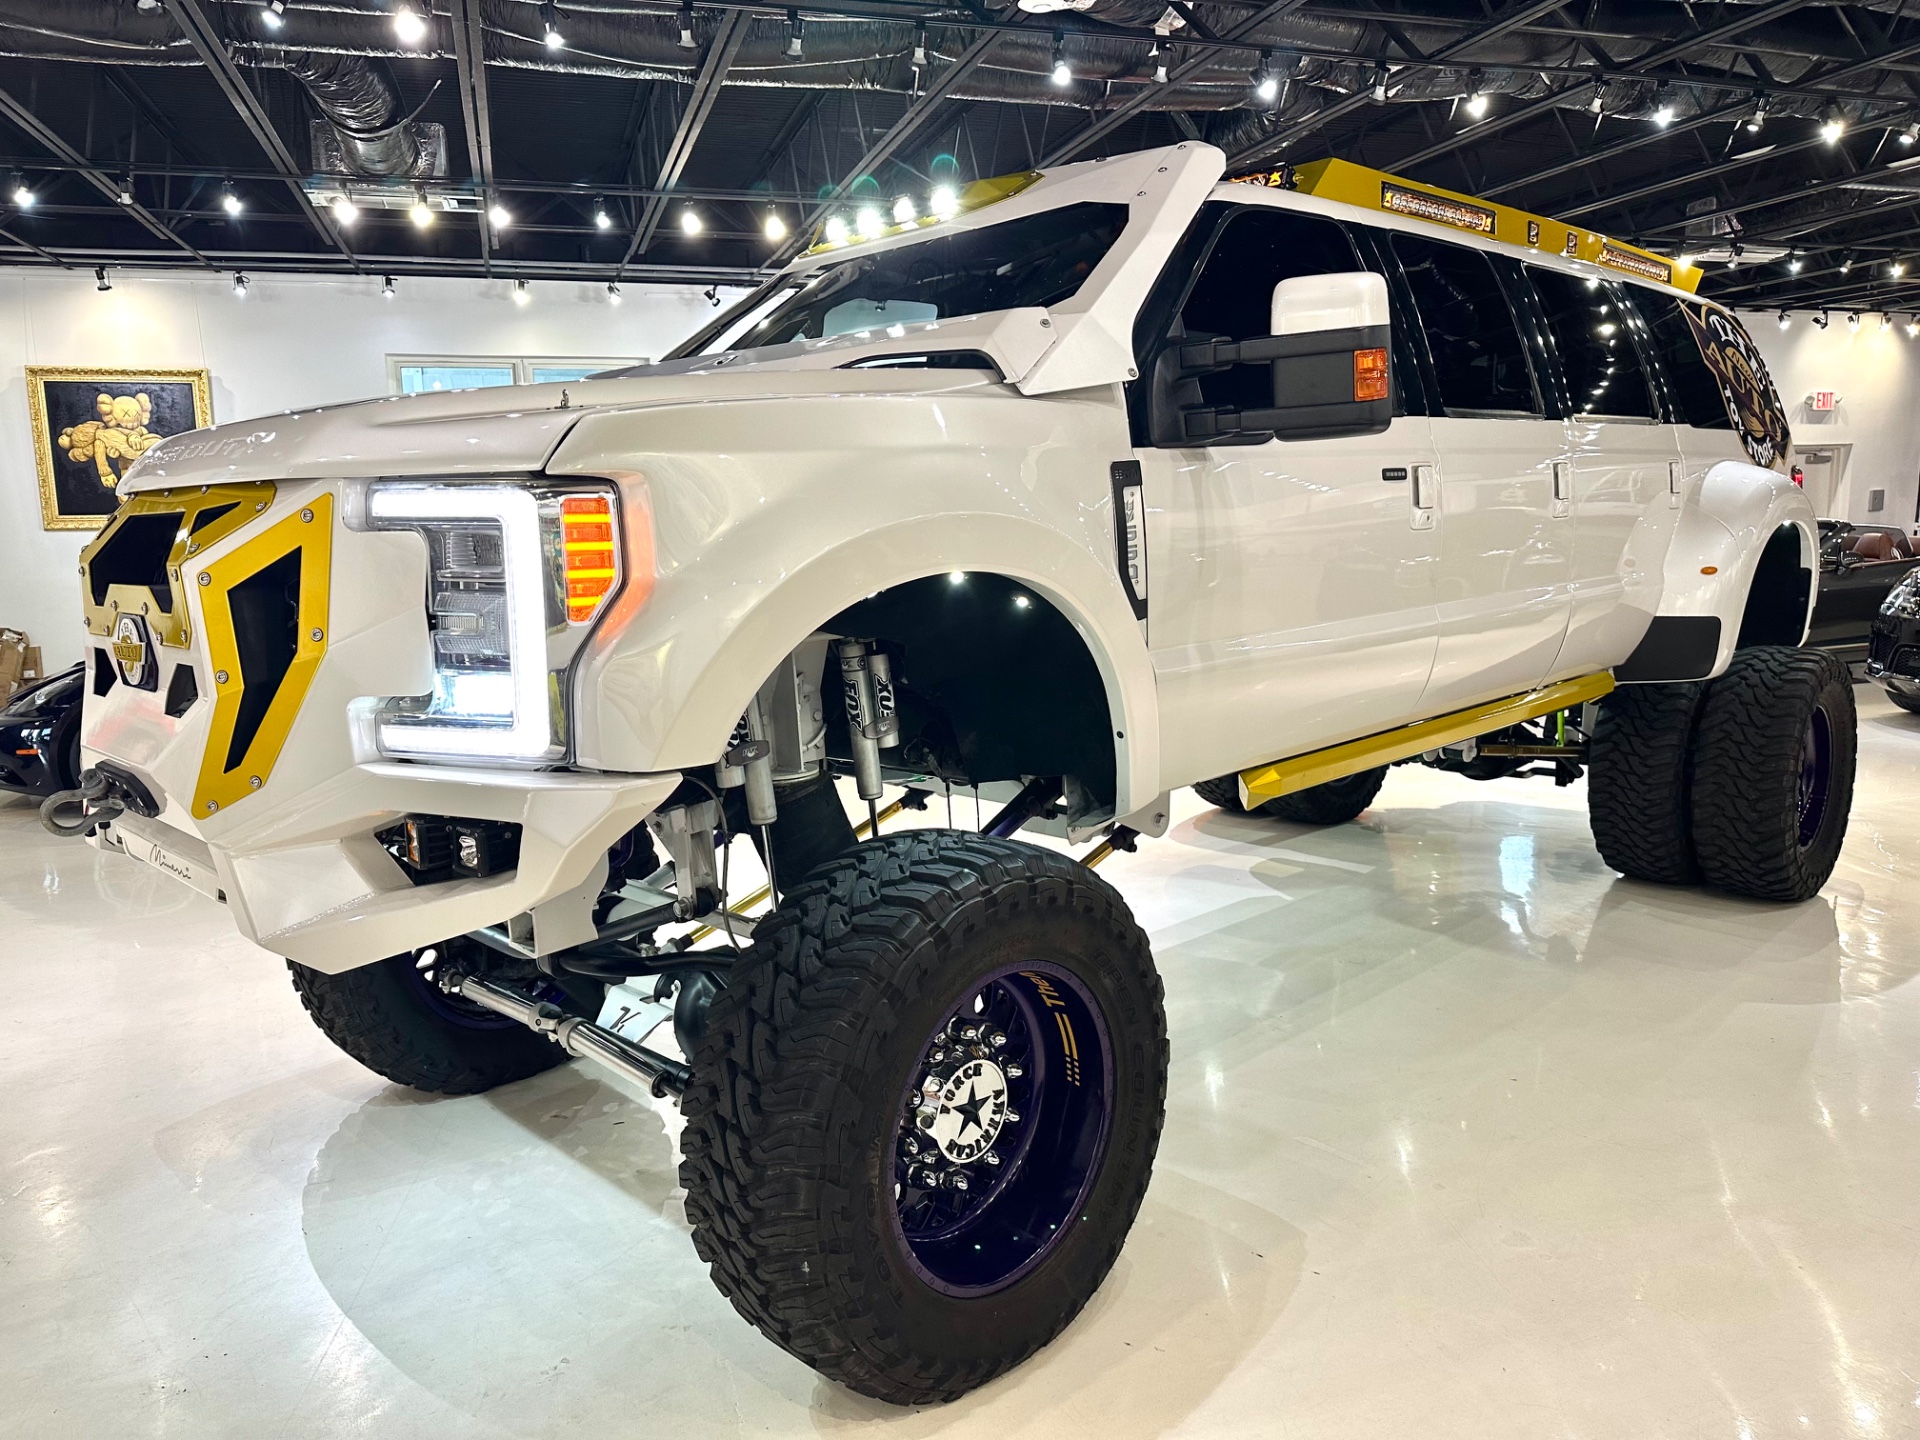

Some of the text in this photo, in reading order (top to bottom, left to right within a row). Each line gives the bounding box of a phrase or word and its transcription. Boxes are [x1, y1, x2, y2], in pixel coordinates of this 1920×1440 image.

[1705, 341, 1782, 442] AUTO
[1724, 384, 1745, 436] TOY
[1816, 392, 1834, 409] EXIT
[1747, 435, 1774, 466] STORE
[115, 645, 138, 658] AUTO
[843, 677, 864, 732] FOX
[940, 1063, 983, 1115] FORCE
[945, 1088, 1006, 1159] AMERICAN
